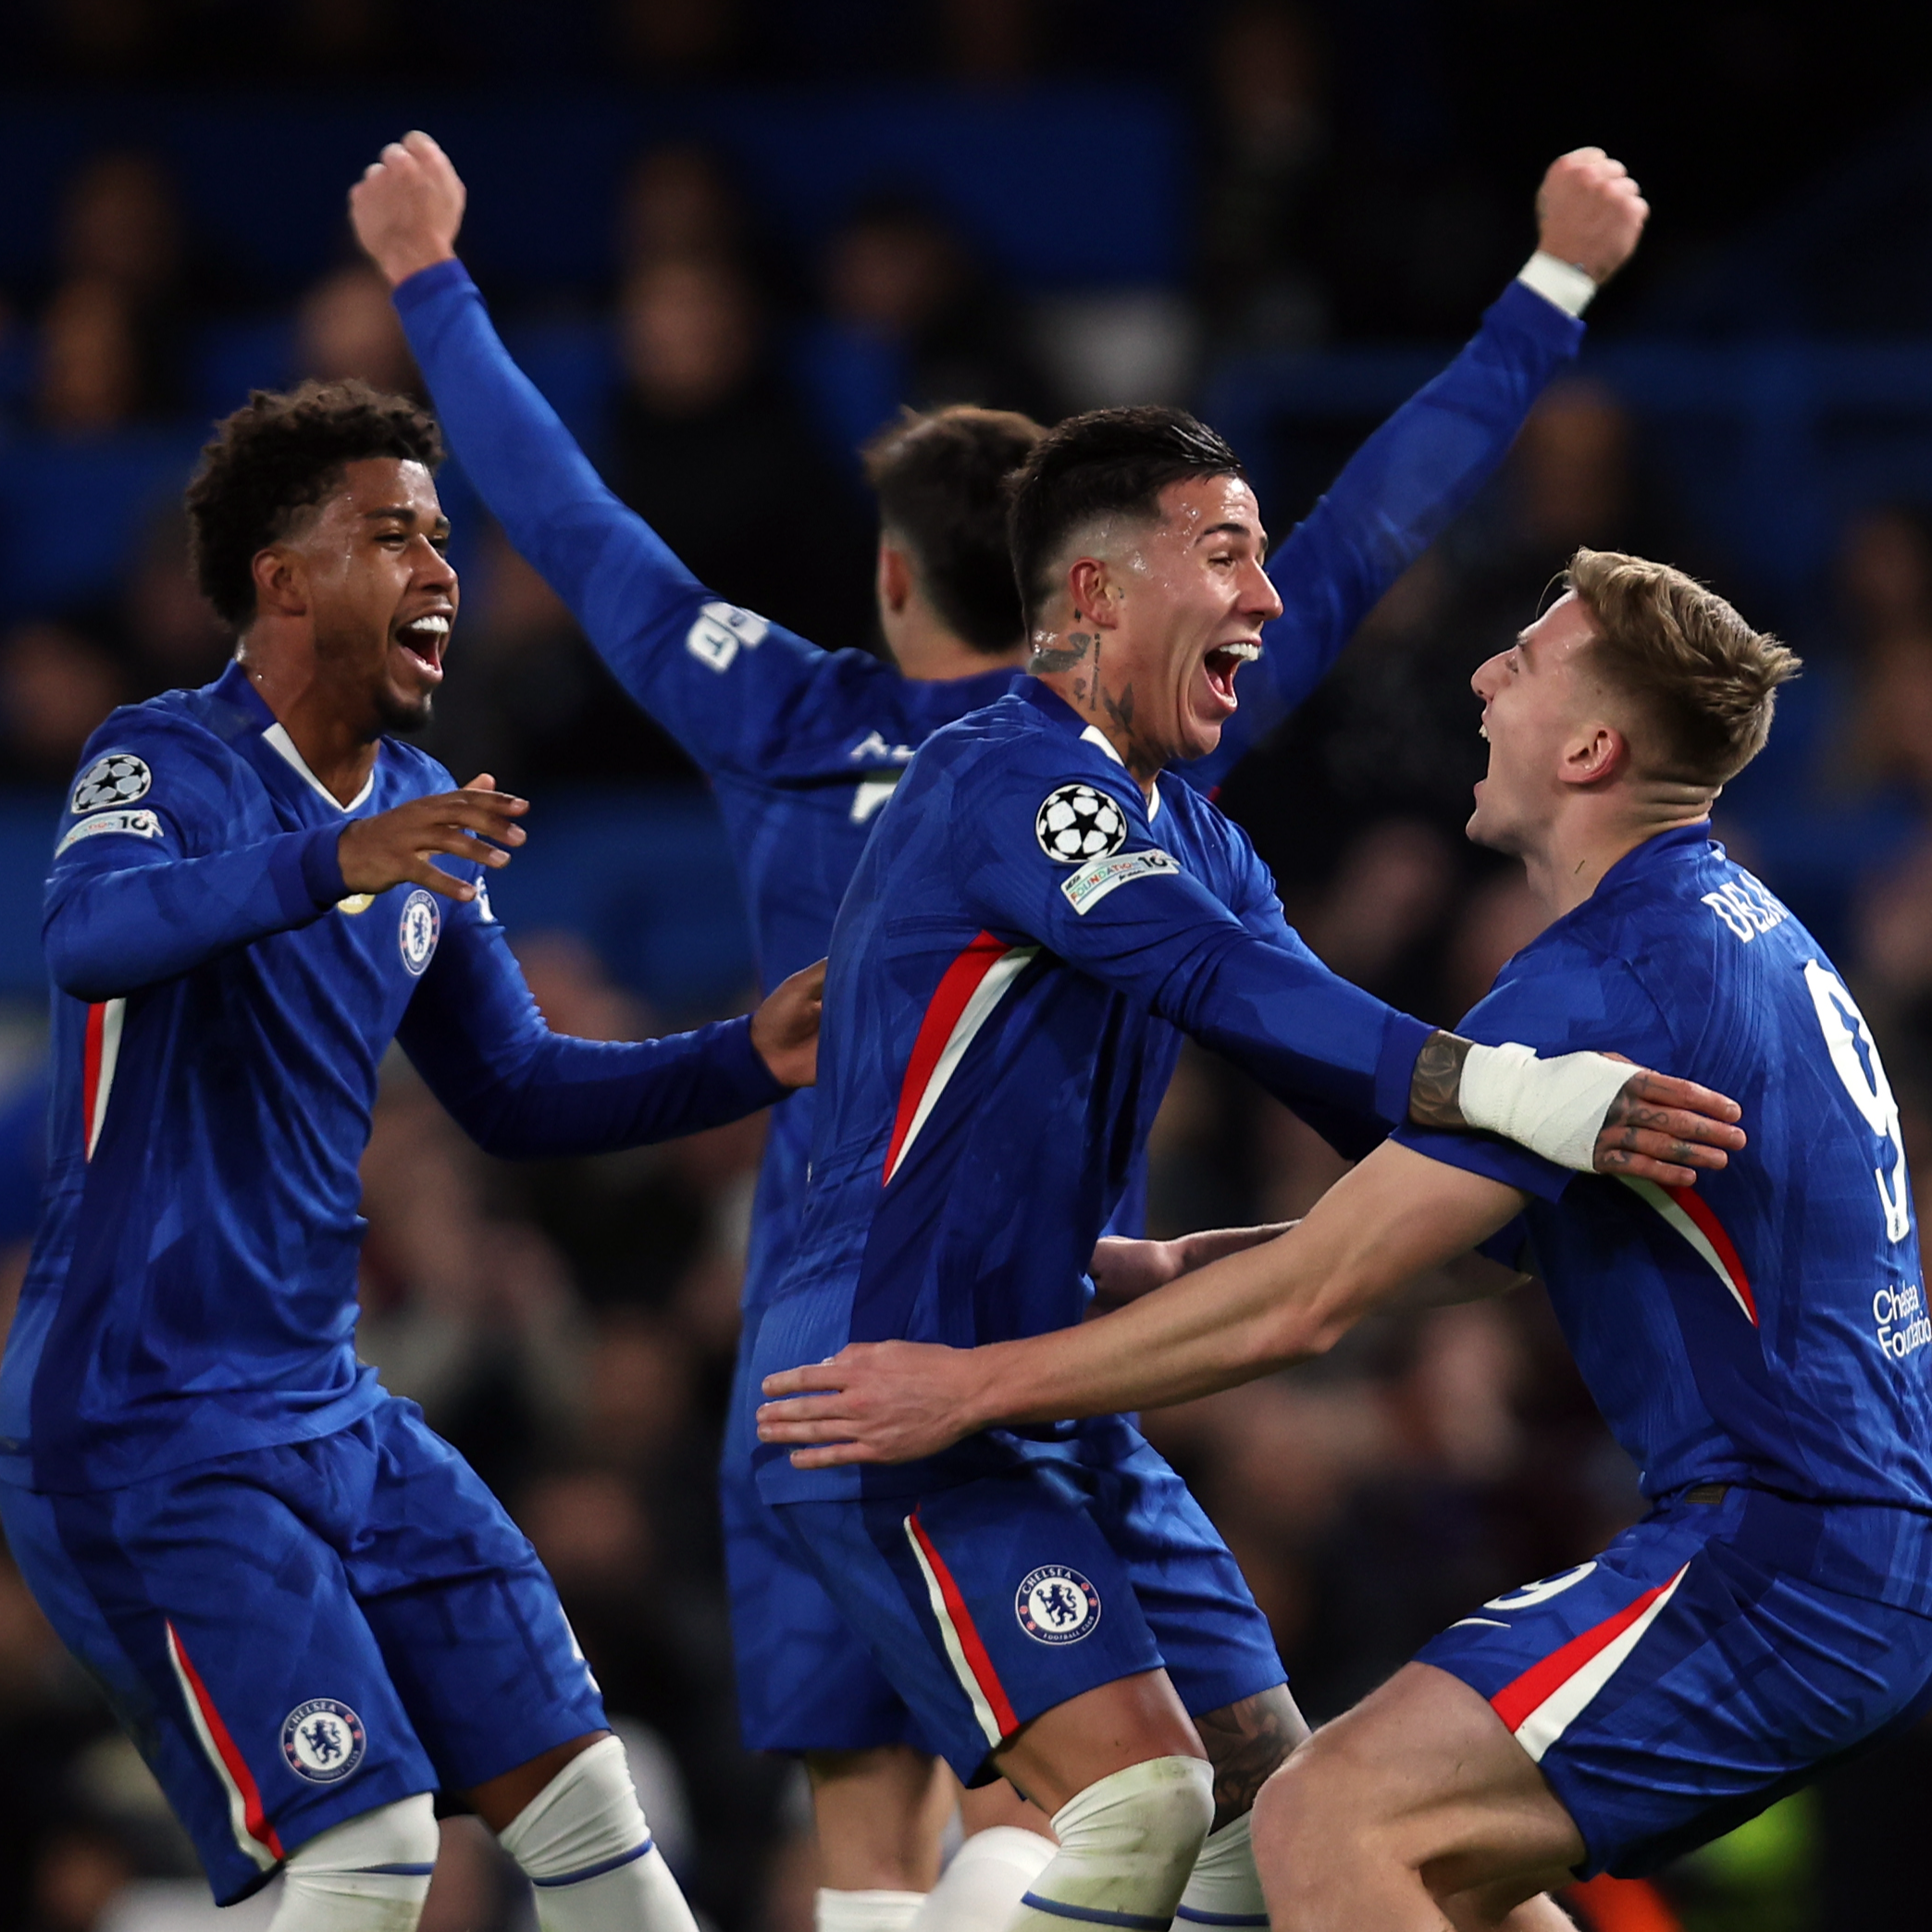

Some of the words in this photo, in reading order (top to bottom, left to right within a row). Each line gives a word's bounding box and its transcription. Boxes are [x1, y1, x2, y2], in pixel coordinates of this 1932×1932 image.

[1804, 959, 1910, 1245] 9
[1873, 1279, 1920, 1325] Chelsea
[1876, 1309, 1932, 1360] Foundatio
[1022, 1567, 1071, 1595] CHELSEA
[1043, 1631, 1080, 1641] FOOTBALL
[1081, 1615, 1095, 1631] CLUB
